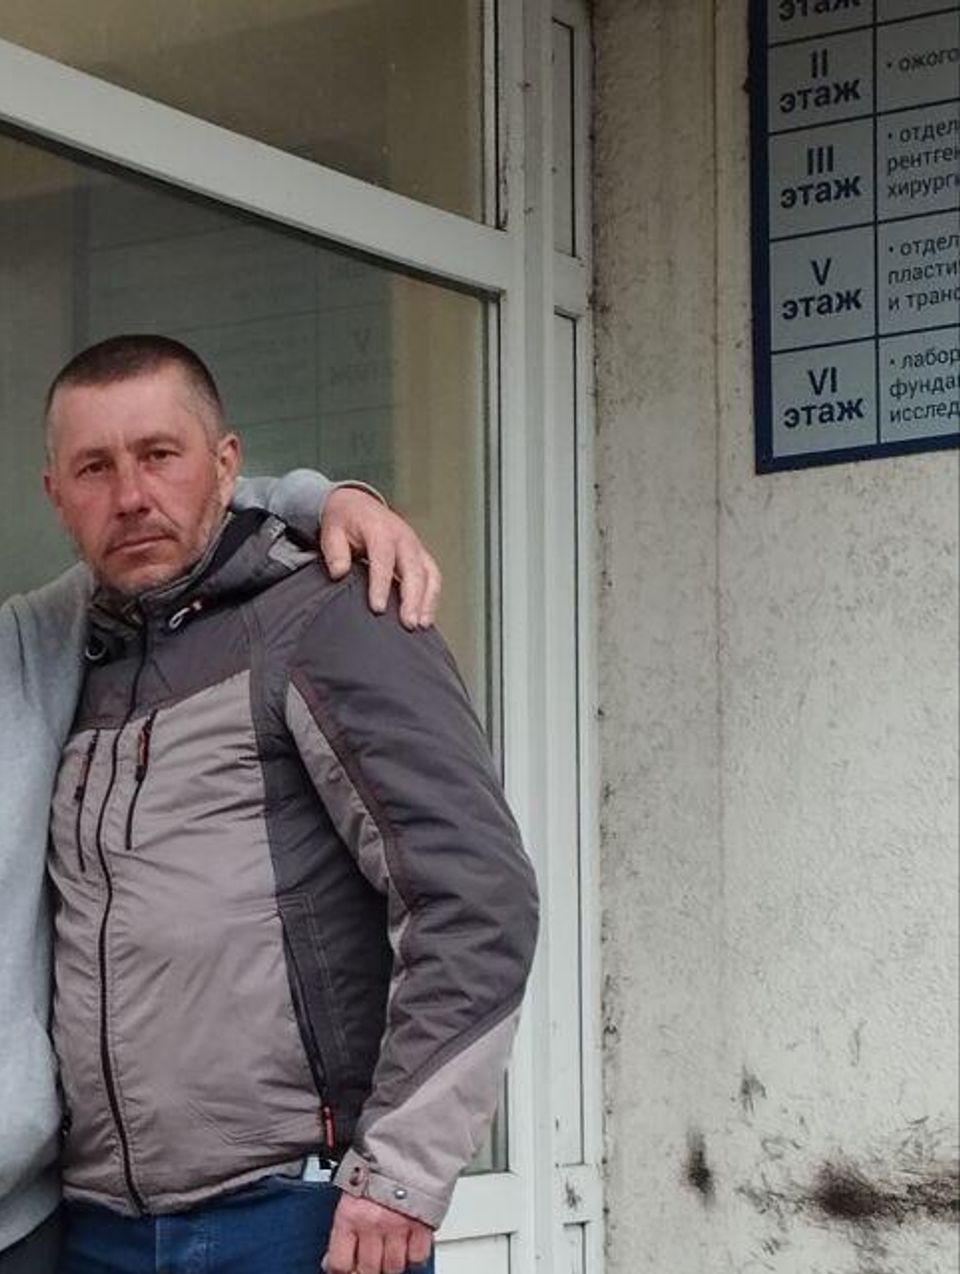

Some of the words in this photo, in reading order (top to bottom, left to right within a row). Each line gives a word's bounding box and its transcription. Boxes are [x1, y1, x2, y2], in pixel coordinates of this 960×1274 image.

[811, 49, 828, 78] II
[778, 79, 861, 113] этаж
[807, 143, 834, 175] III
[780, 175, 862, 209] этаж
[810, 257, 832, 286] V
[888, 262, 960, 284] пласти
[781, 288, 863, 320] этаж
[889, 297, 900, 310] и
[807, 366, 838, 396] VI
[889, 377, 960, 400] фунда
[783, 398, 865, 428] этаж
